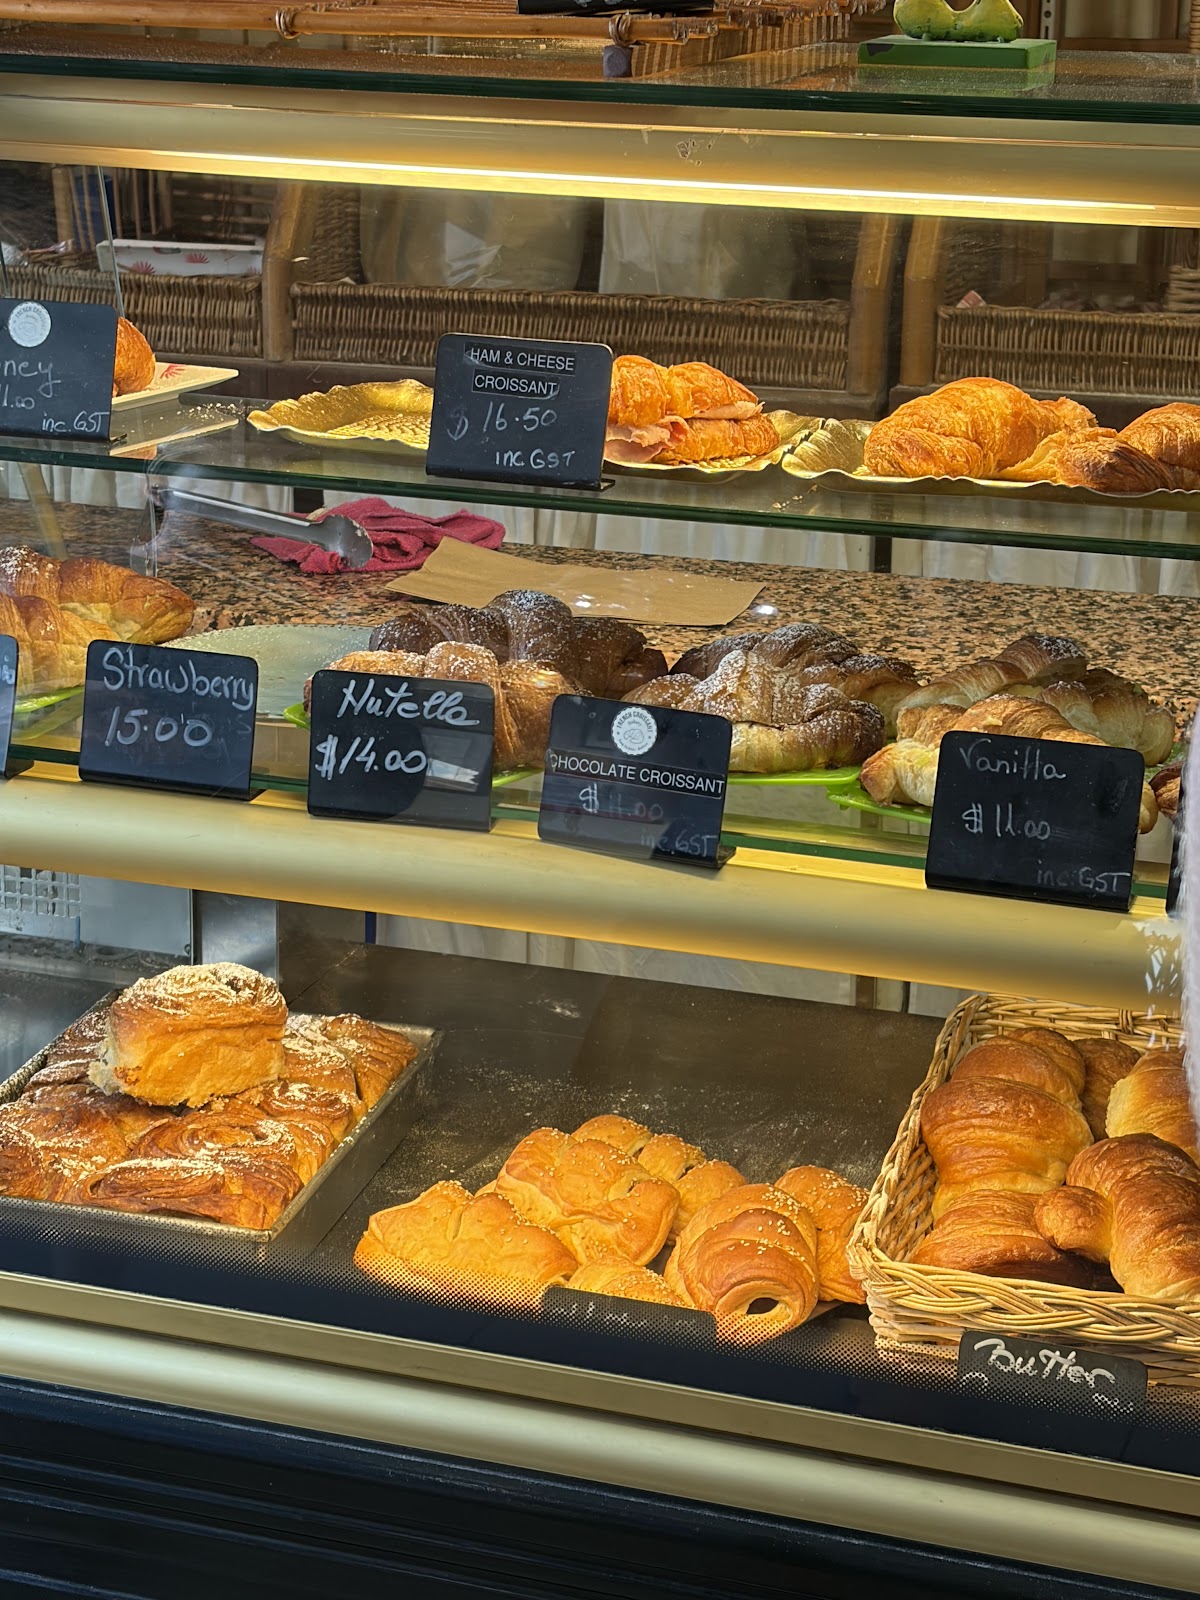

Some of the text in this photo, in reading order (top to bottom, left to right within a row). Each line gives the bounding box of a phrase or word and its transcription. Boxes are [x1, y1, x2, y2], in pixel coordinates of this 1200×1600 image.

[0, 359, 61, 398] ney
[470, 347, 575, 371] HAM & CHEESE
[474, 374, 558, 395] CROISSANT
[529, 448, 576, 470] GST
[102, 647, 254, 711] Strawberry
[336, 678, 480, 726] Nutella
[616, 711, 632, 729] FRENCH
[550, 753, 725, 794] CHOCOLATE CROISSANT
[960, 738, 1067, 781] Vanilla
